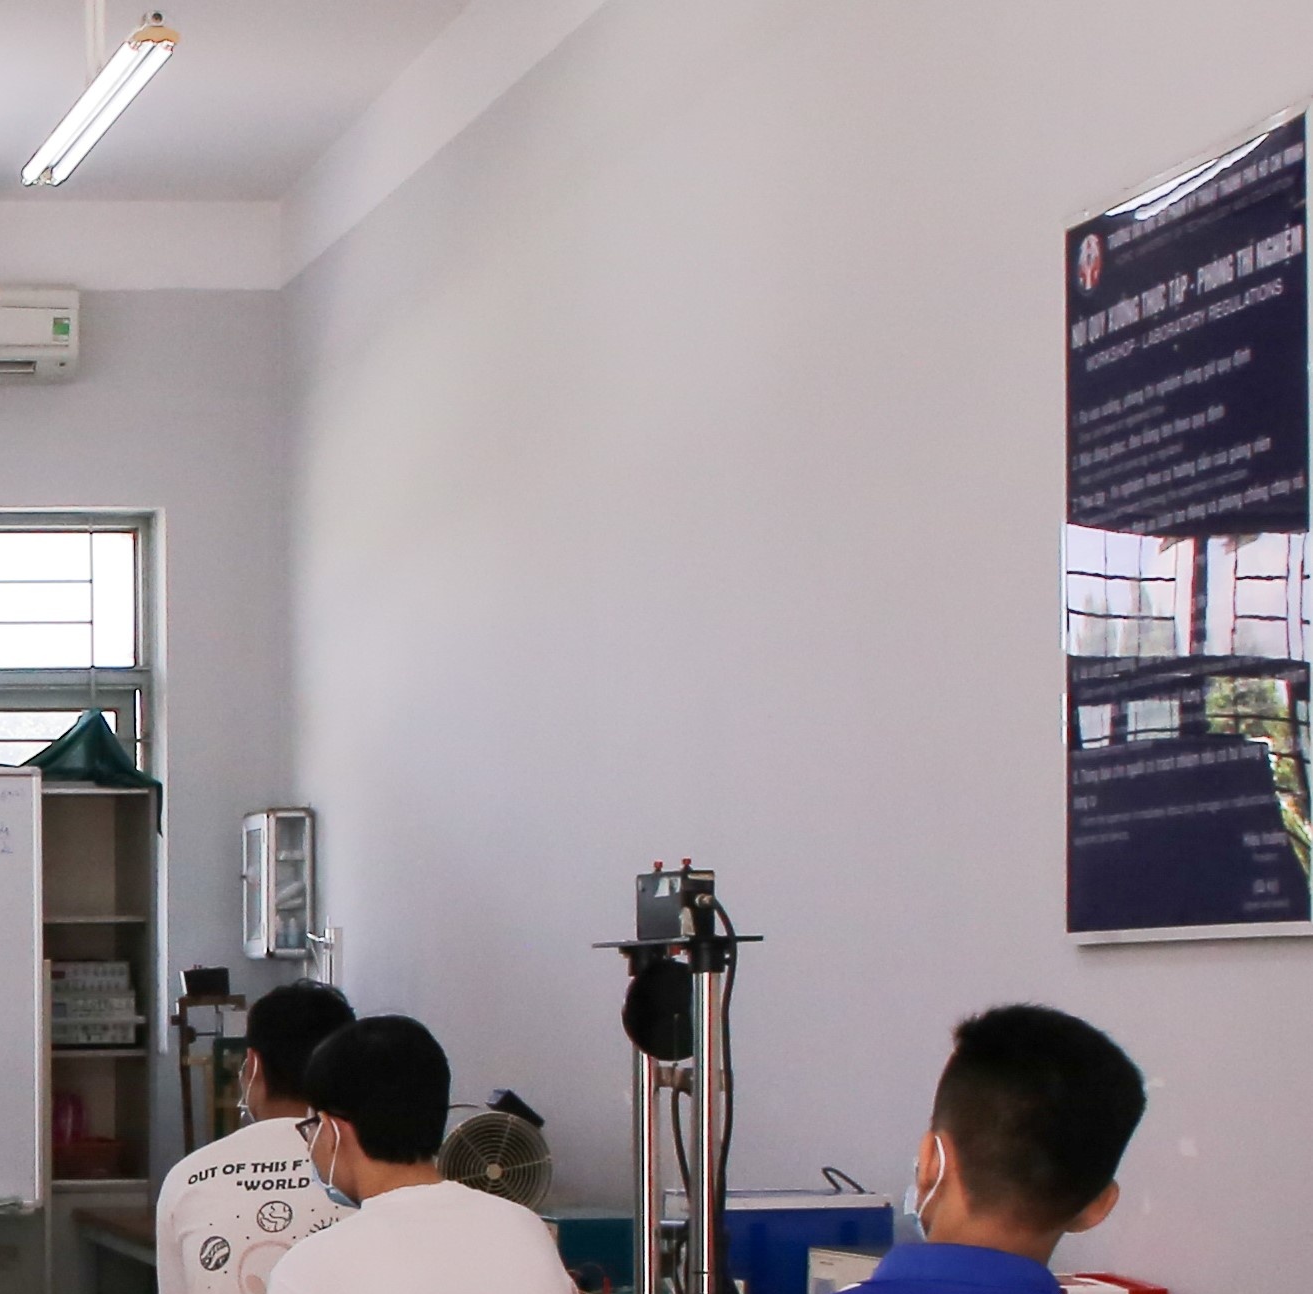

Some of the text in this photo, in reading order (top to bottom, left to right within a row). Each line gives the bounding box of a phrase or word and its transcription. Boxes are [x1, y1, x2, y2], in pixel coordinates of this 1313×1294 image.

[187, 1166, 218, 1185] OUT
[222, 1163, 246, 1175] OF
[251, 1161, 287, 1173] THIS
